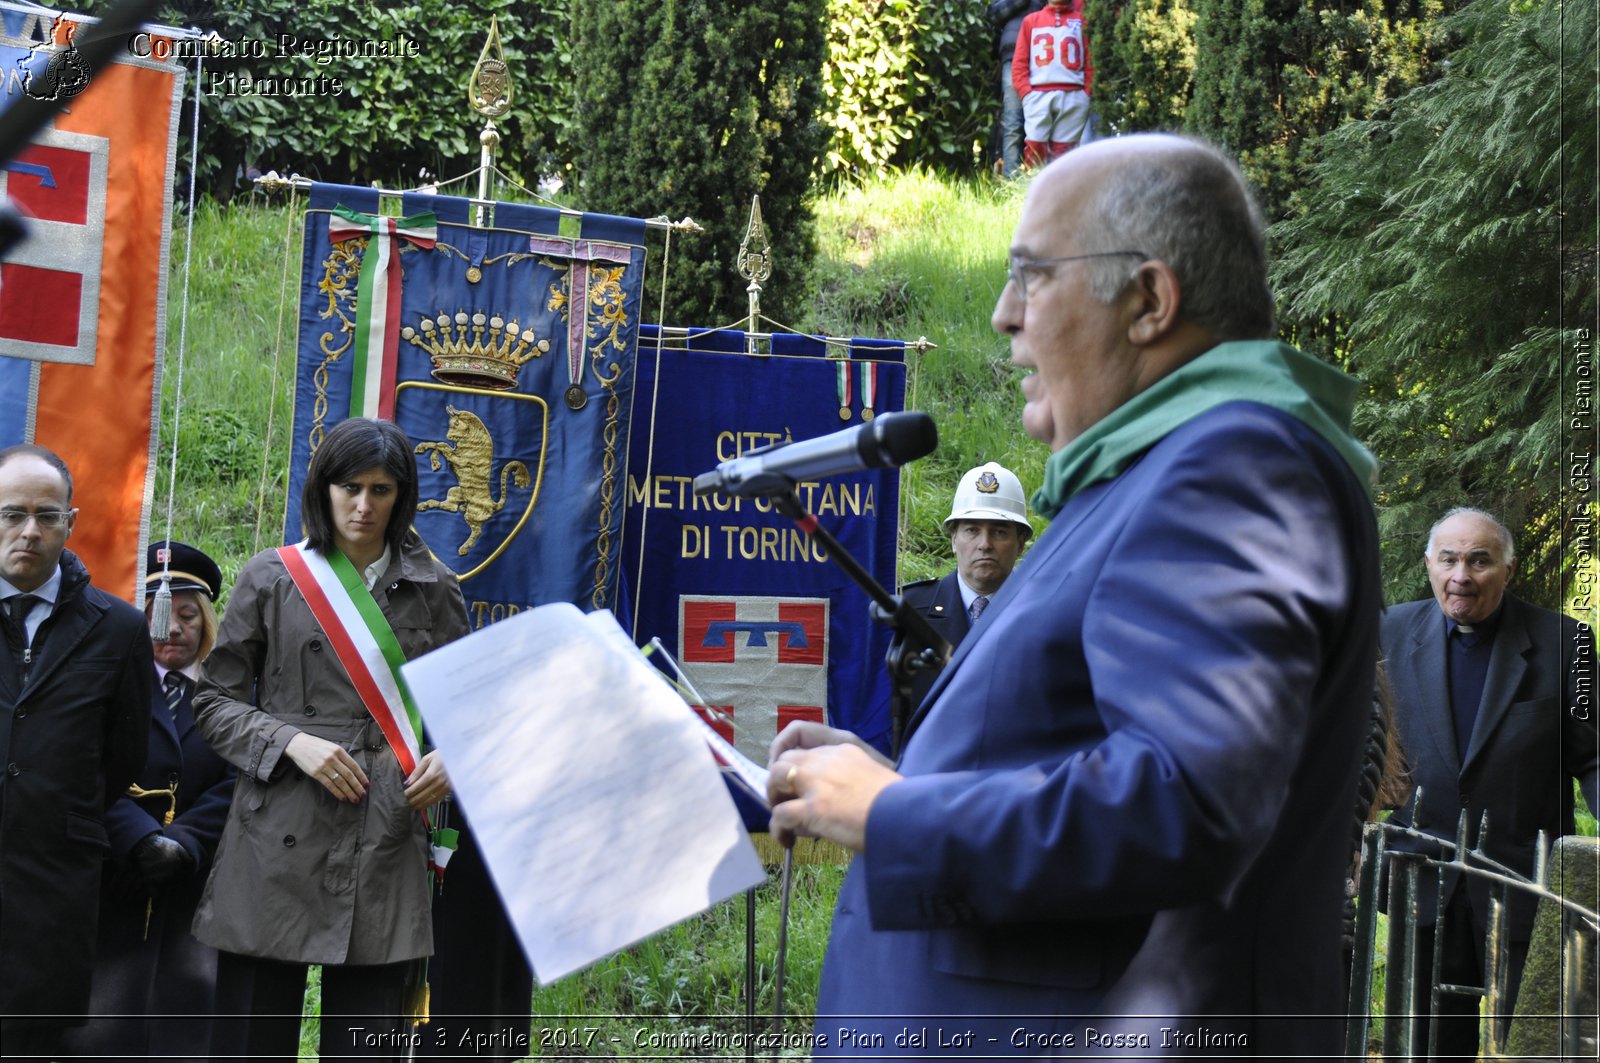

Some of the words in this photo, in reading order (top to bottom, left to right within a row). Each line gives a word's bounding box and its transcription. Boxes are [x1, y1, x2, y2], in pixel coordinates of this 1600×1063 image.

[1033, 32, 1081, 72] 30
[681, 524, 710, 560] DI
[721, 525, 832, 563] TORINO
